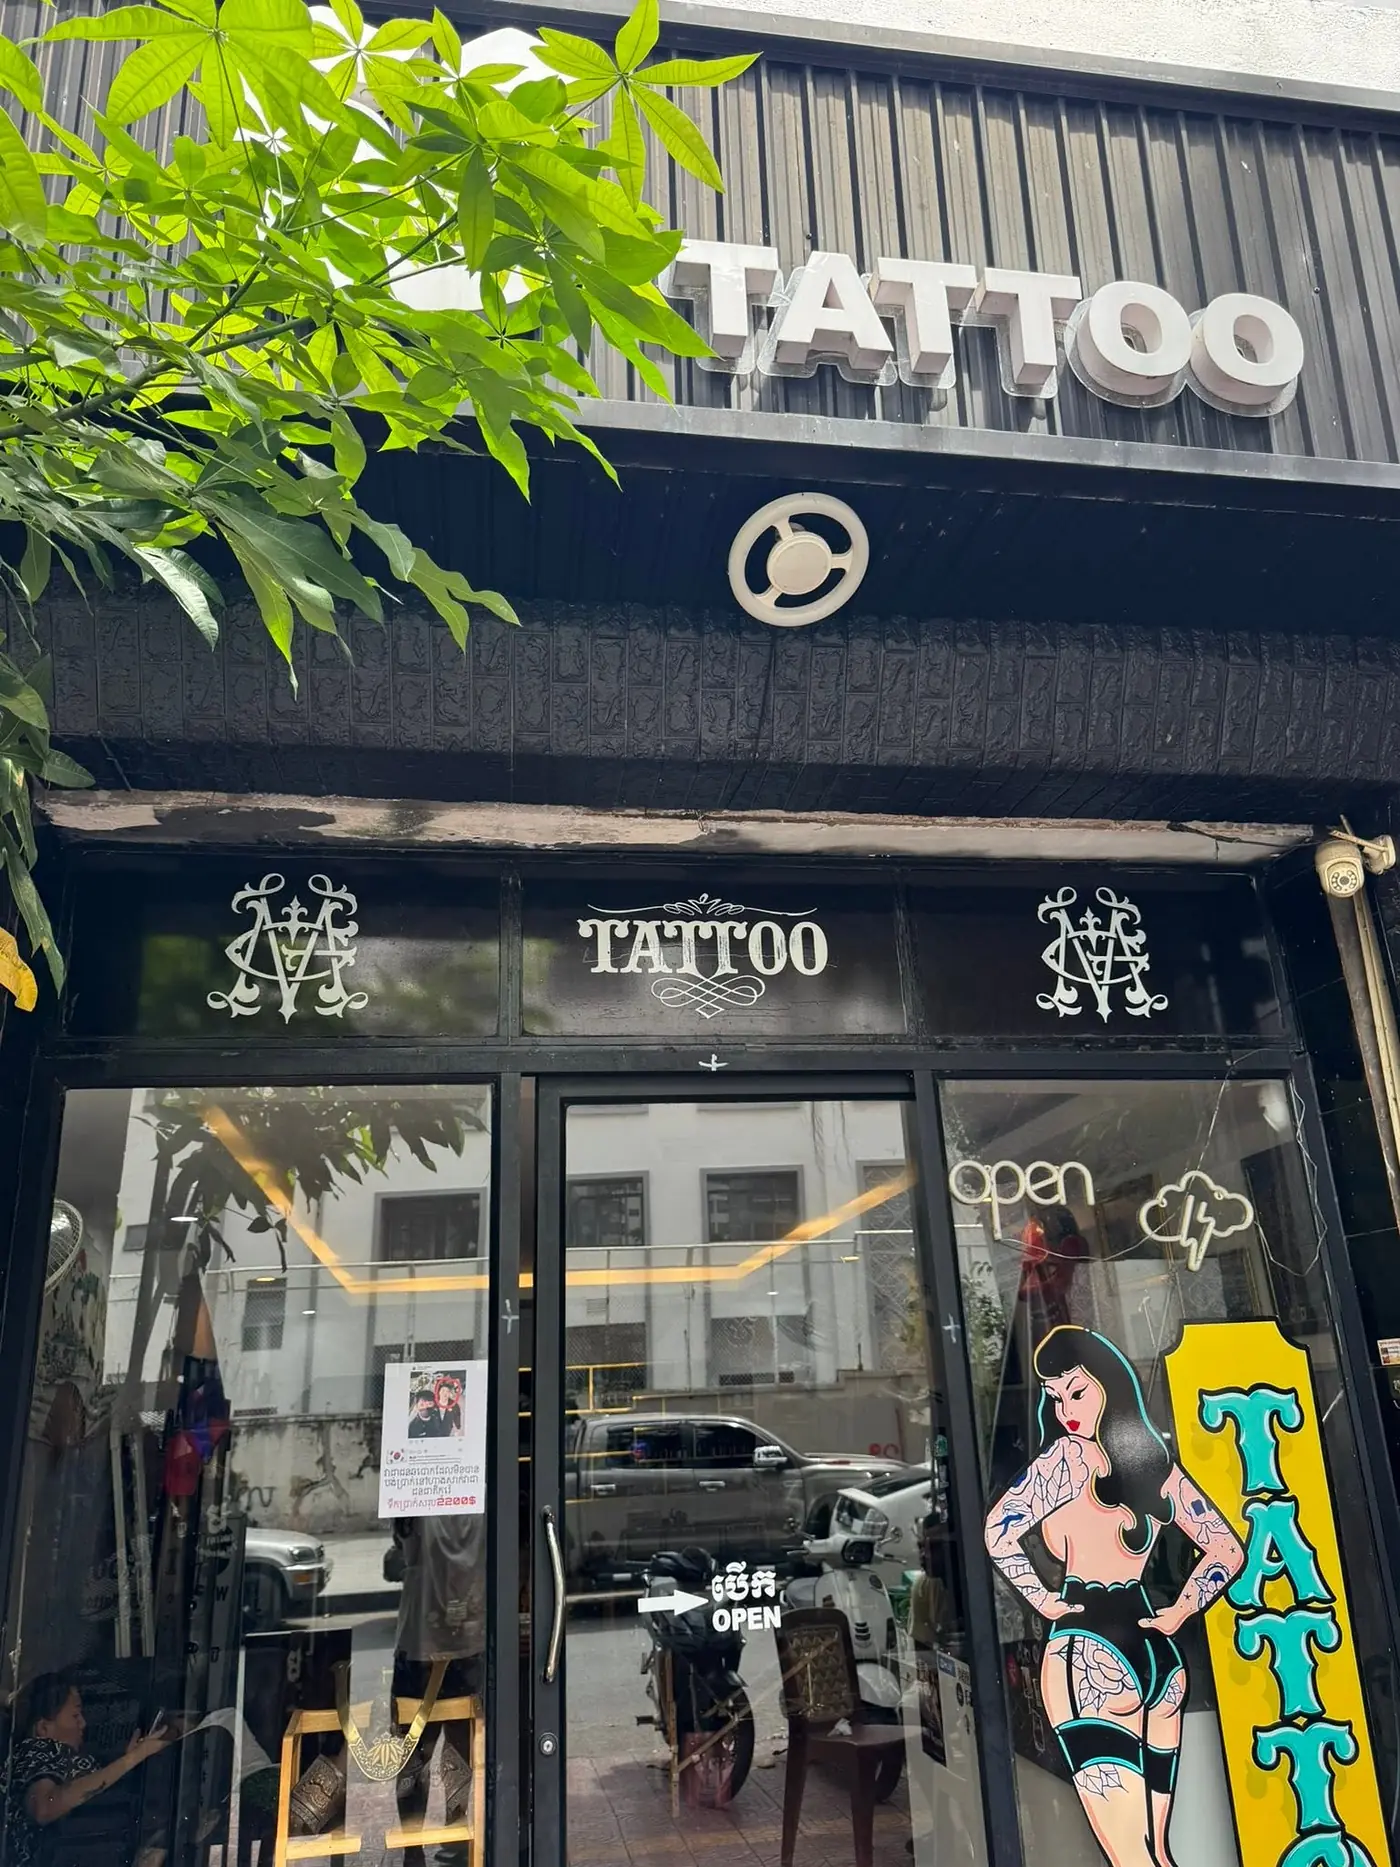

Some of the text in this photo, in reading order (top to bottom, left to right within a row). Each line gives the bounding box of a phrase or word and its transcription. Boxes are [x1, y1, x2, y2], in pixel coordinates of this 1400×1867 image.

[664, 239, 1305, 405] TATTOO
[577, 918, 829, 976] TATTOO
[948, 1159, 1096, 1240] open
[711, 1561, 777, 1602] បើក
[712, 1605, 782, 1632] OPEN
